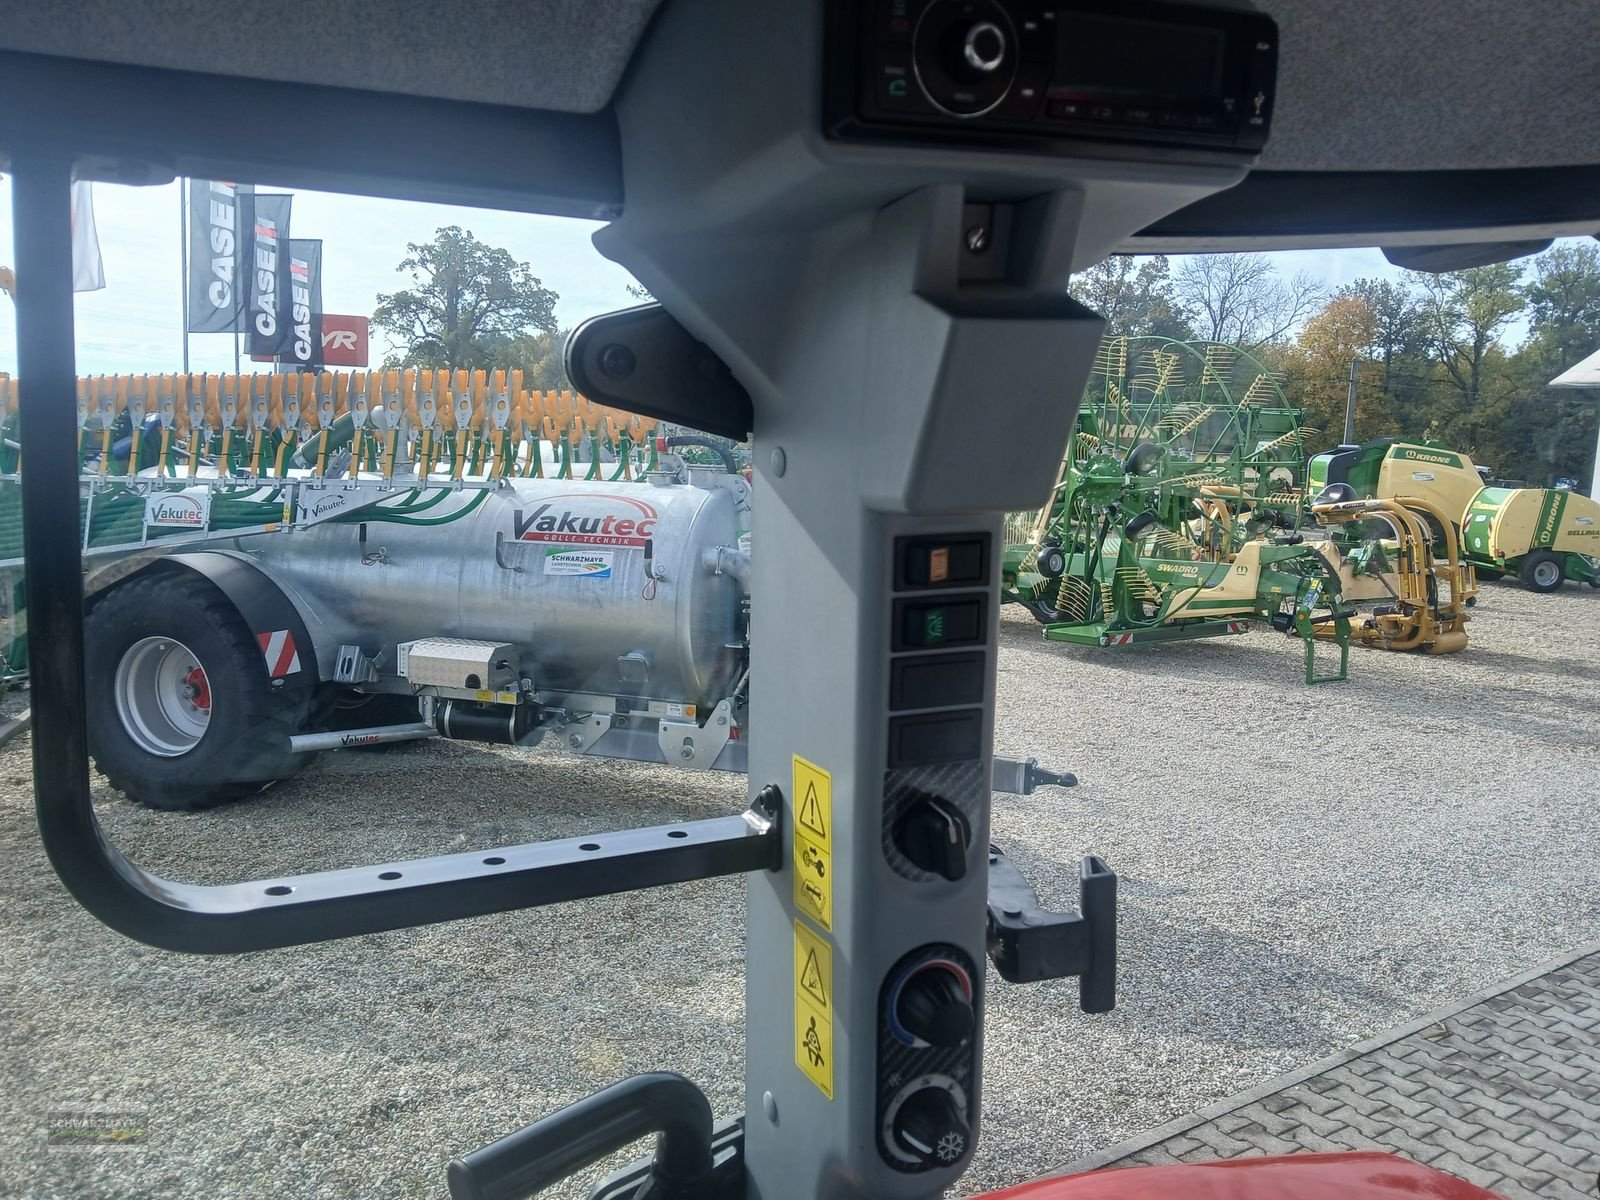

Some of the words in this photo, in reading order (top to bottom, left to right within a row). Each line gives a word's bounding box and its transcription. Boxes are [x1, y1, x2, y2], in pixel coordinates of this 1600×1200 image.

[208, 199, 236, 309] CASE
[255, 247, 276, 337] CASE
[292, 285, 312, 361] CASE
[1416, 453, 1451, 464] KRONE
[151, 503, 202, 522] Vakutec
[312, 499, 345, 517] Vakutec
[1547, 494, 1562, 533] KRONE
[513, 503, 657, 541] Vakutec
[551, 554, 604, 563] SCHWARZMAYR
[1156, 563, 1199, 574] SWADRO
[341, 734, 379, 746] Vakutec
